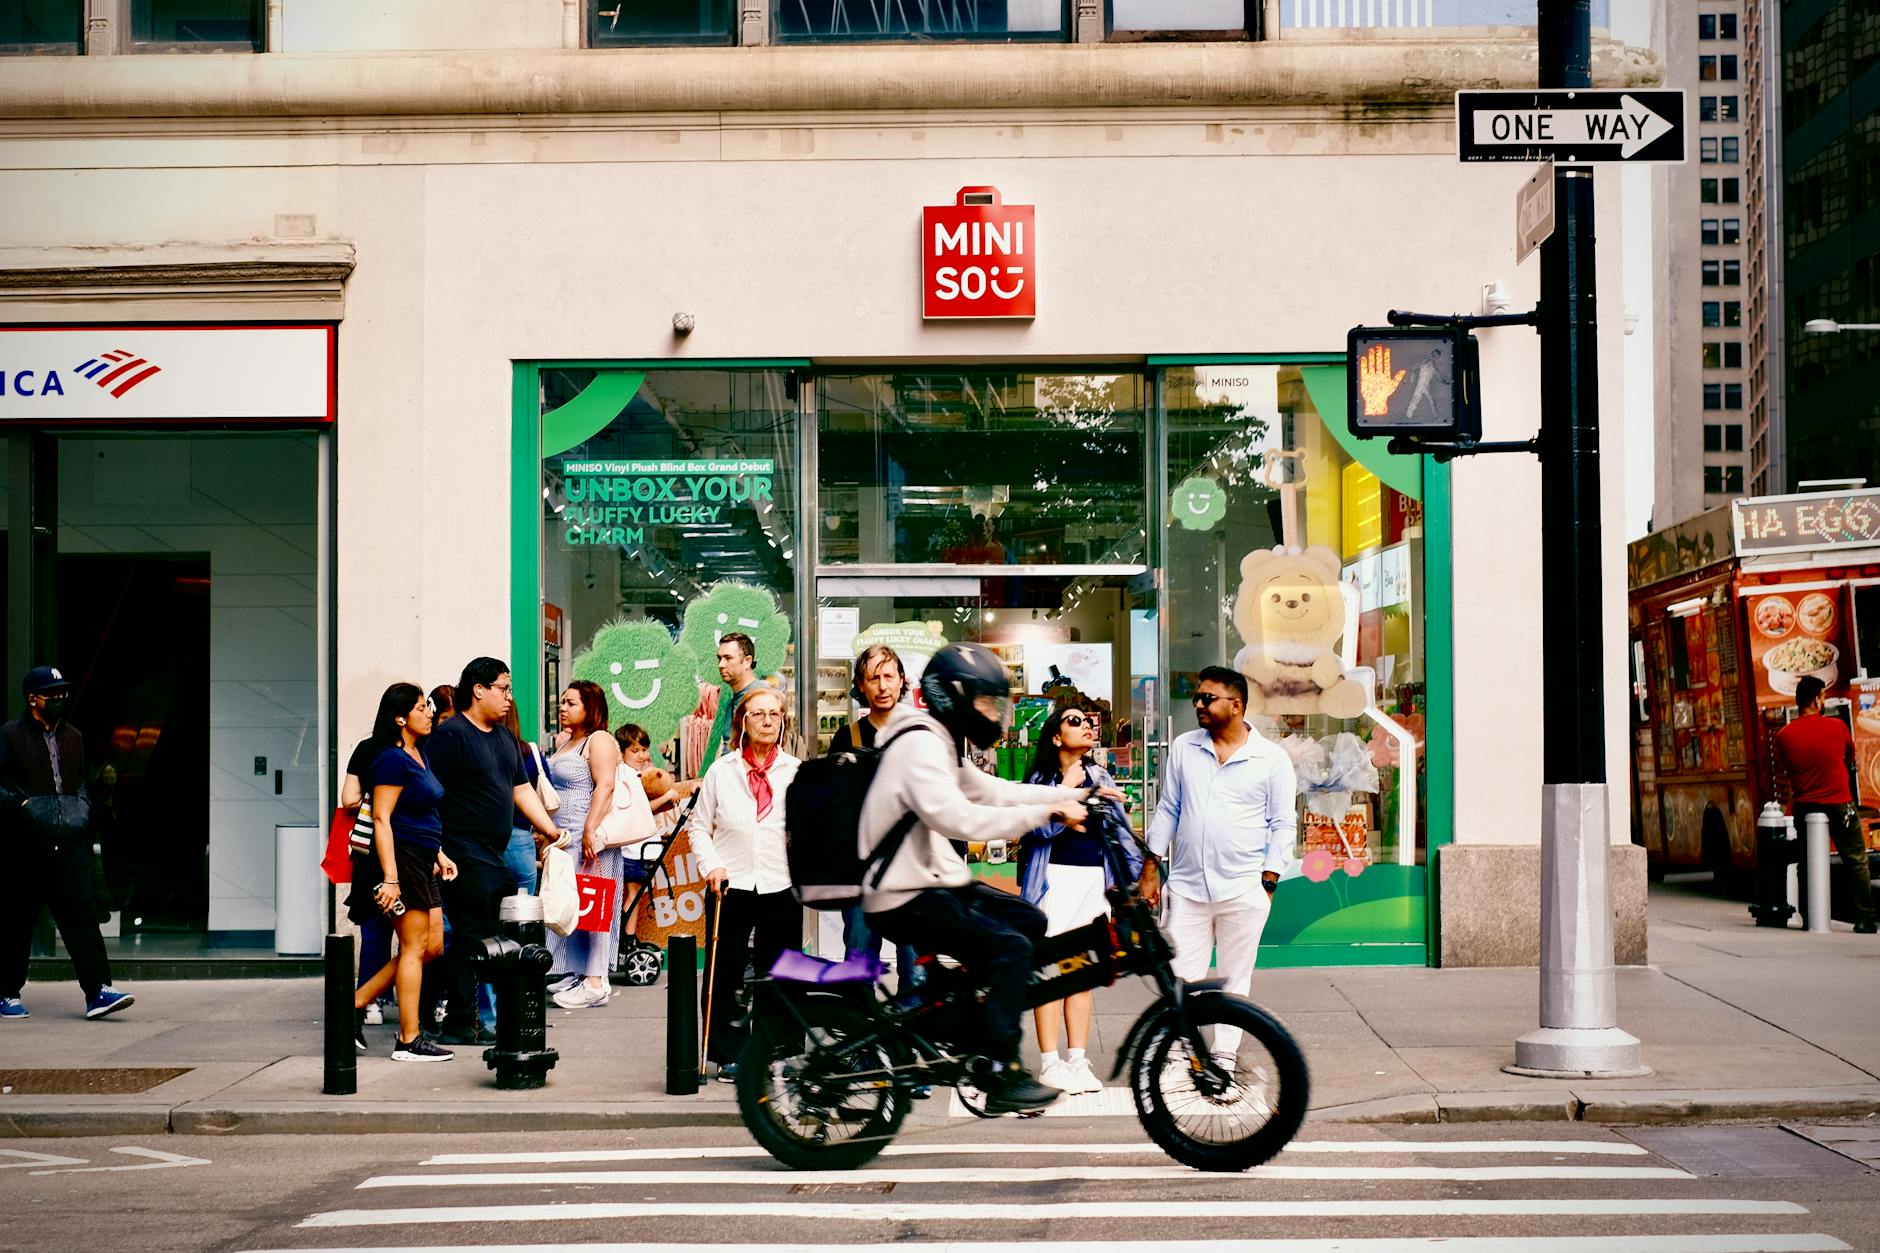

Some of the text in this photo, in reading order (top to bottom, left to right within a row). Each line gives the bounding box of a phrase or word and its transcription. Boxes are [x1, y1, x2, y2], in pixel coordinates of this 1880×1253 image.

[1491, 113, 1650, 141] ONE WAY
[934, 221, 1024, 256] MINI
[1211, 377, 1250, 388] MINISO
[566, 461, 771, 475] MINISO Vinyl Plush Blind Box Grand Debut
[565, 476, 774, 502] UNBOX YOUR
[565, 505, 721, 525] FLUFFY LUCKY
[565, 527, 644, 545] CHARM
[903, 628, 925, 637] YOUR
